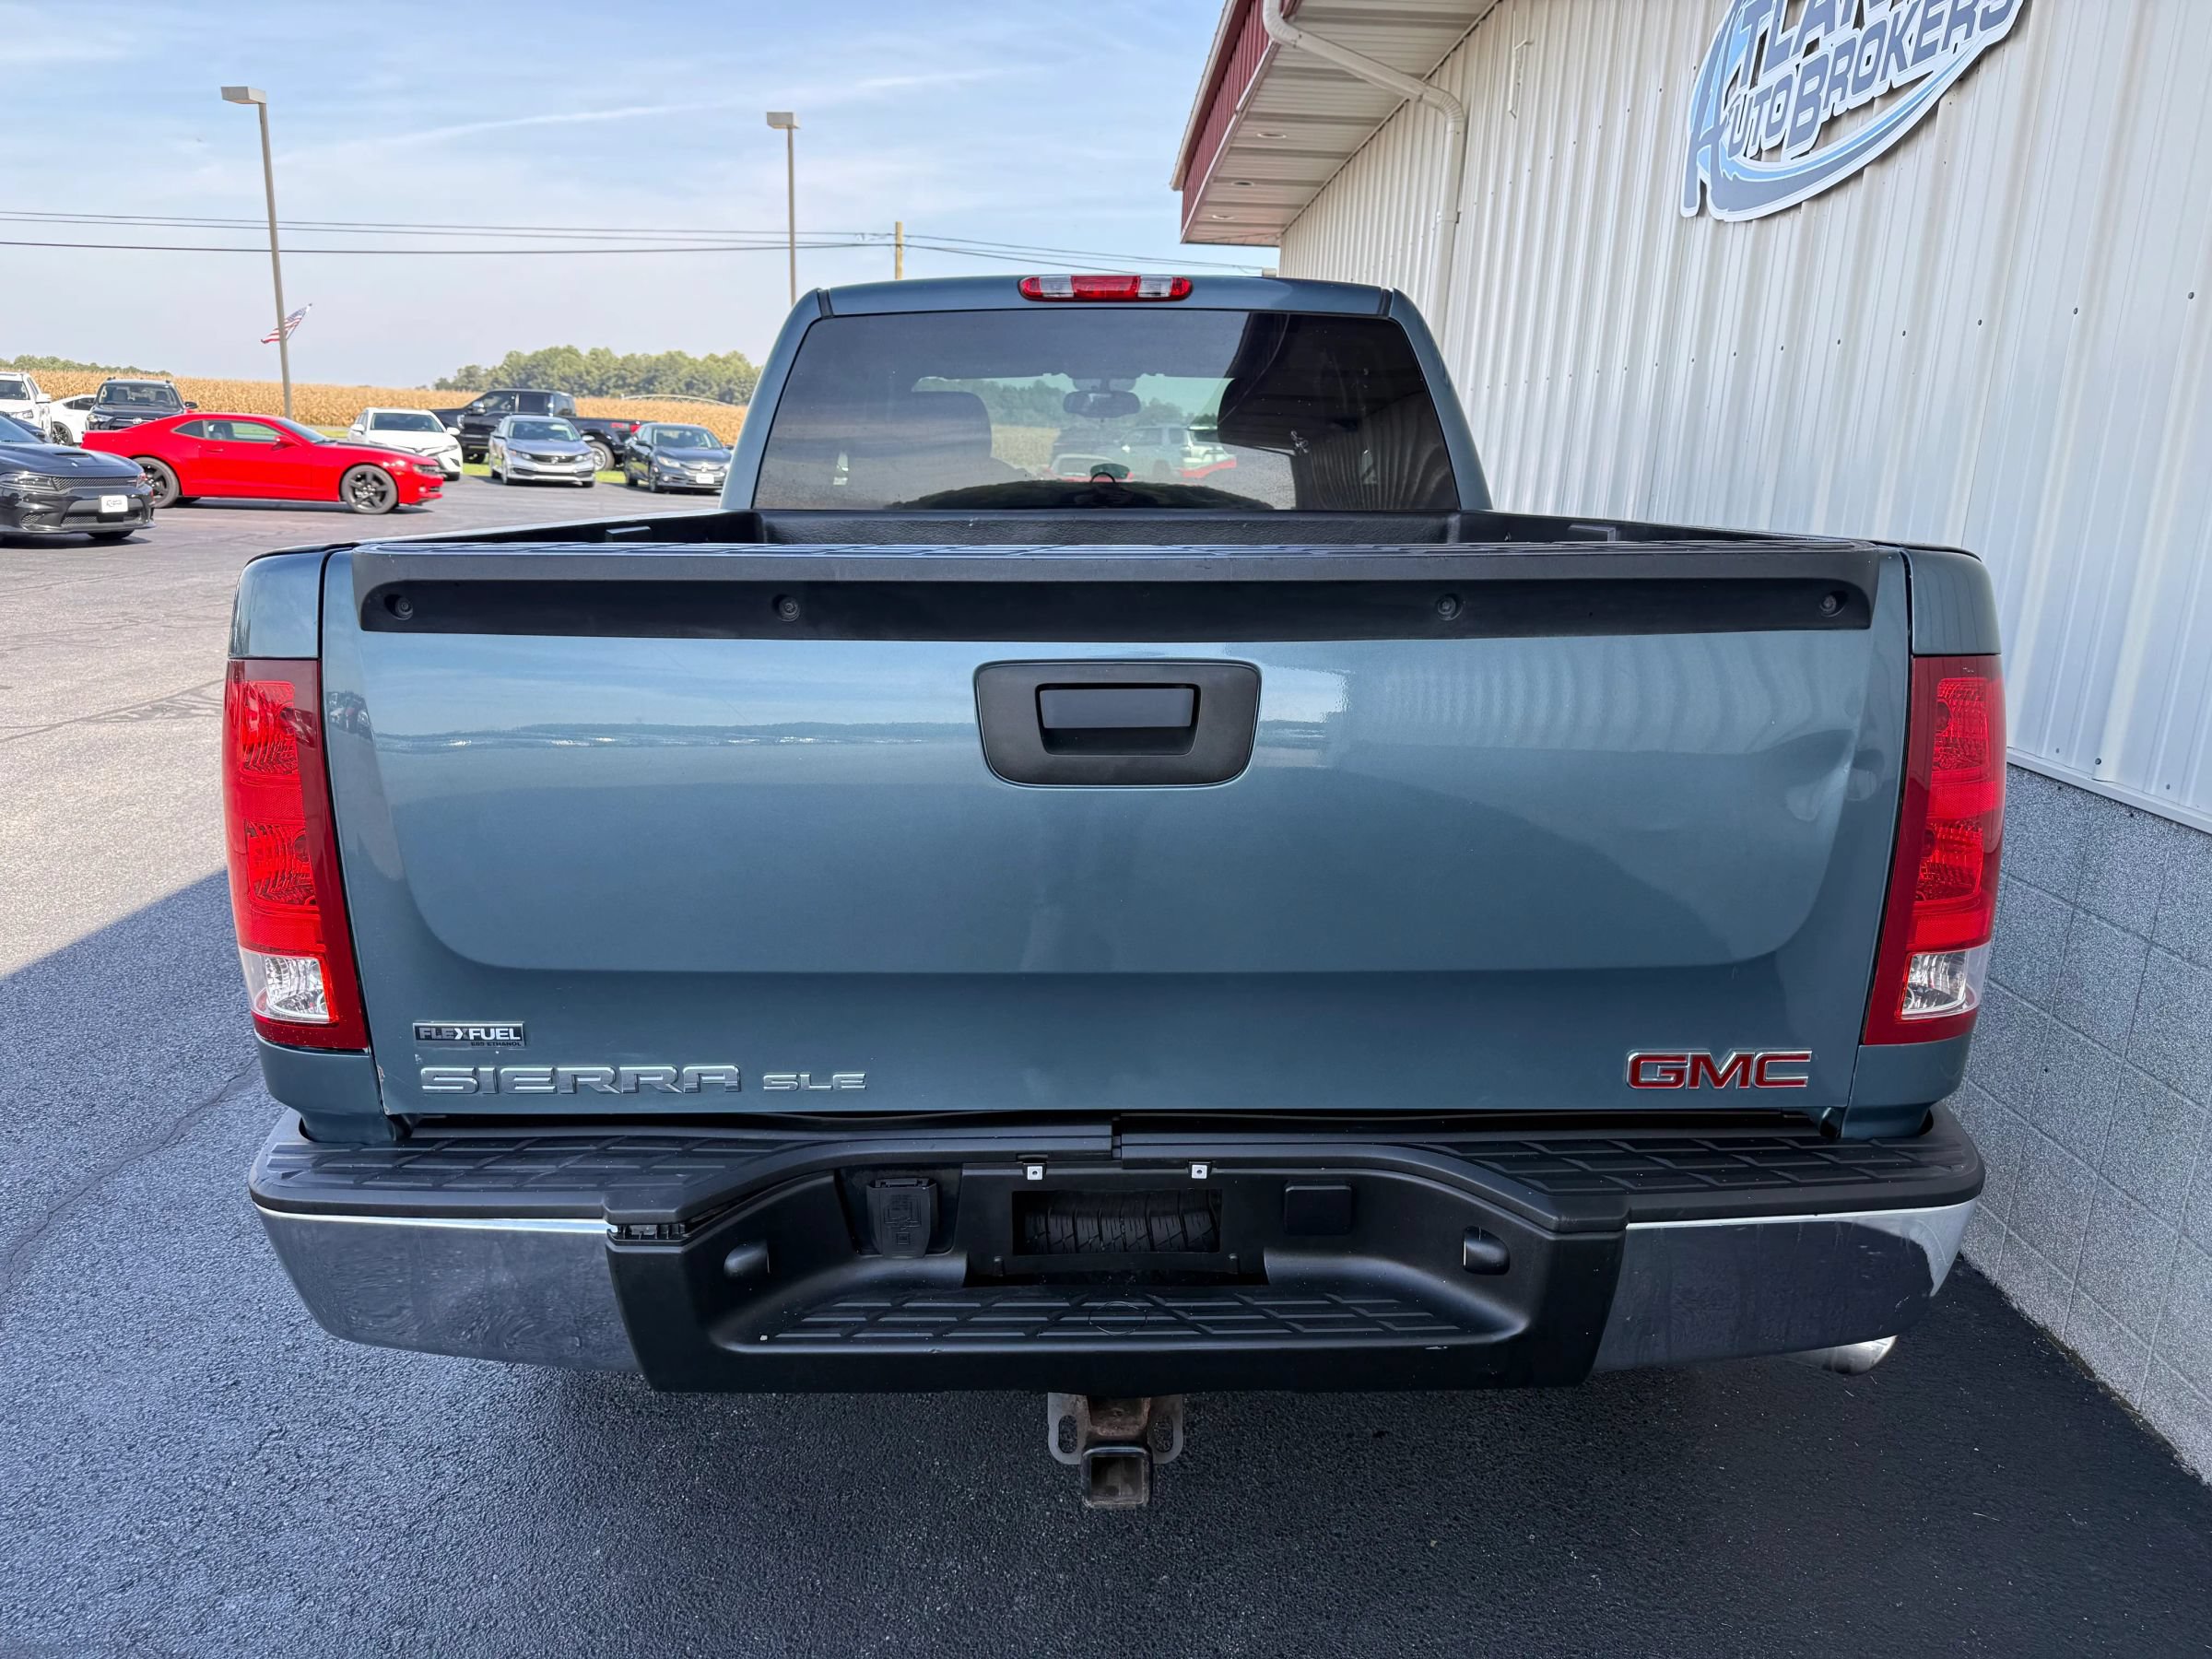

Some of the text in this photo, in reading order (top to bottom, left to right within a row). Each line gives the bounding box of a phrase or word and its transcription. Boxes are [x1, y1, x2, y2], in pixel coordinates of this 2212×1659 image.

[418, 1027, 522, 1041] FLEXFUEL
[420, 1065, 867, 1094] SIERRA SLE
[1626, 1049, 1813, 1089] GMC
